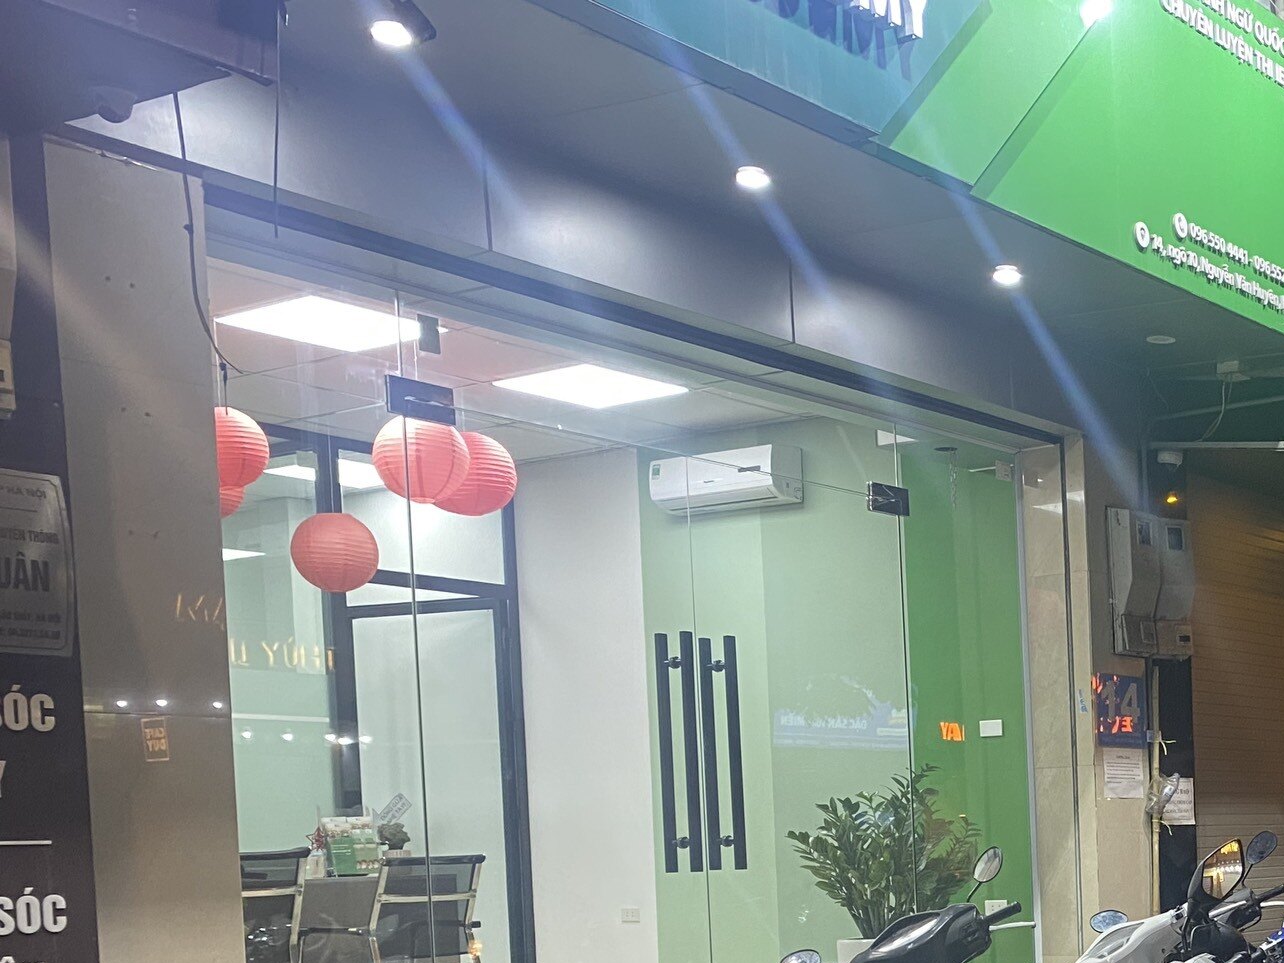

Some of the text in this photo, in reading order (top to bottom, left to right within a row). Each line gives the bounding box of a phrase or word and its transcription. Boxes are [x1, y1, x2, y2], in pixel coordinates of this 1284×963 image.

[1215, 24, 1254, 65] LUYỆN
[1254, 49, 1274, 80] THI
[0, 684, 56, 732] ÓC
